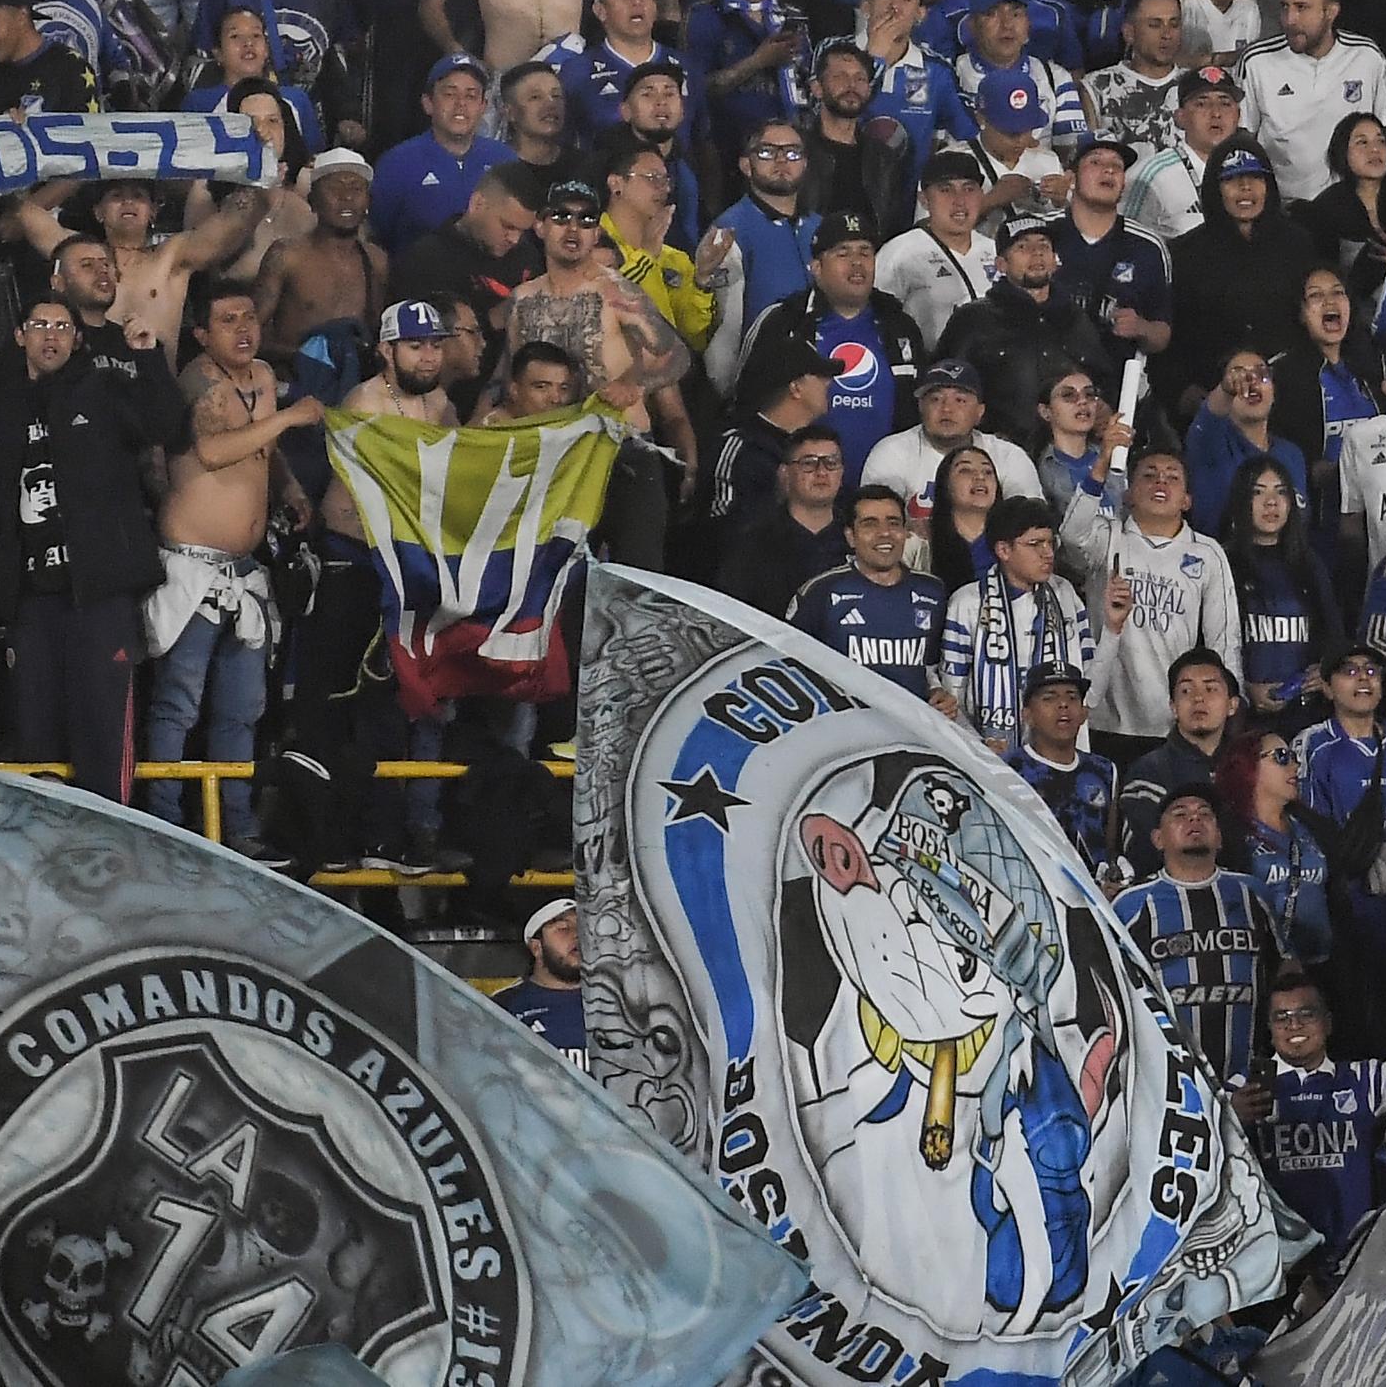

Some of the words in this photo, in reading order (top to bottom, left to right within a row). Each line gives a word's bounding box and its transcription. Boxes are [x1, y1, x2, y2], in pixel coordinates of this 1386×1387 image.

[831, 394, 874, 410] pepsi
[1132, 604, 1172, 634] ORO
[846, 633, 929, 667] ANDINA
[918, 880, 977, 949] BARRIO
[1169, 983, 1255, 1005] SAETA
[6, 969, 339, 1080] COMANDOS
[348, 1049, 502, 1282] AZULES
[143, 1070, 261, 1214] LA
[1257, 1119, 1359, 1160] LEONA
[1280, 1153, 1343, 1170] CERVEZA
